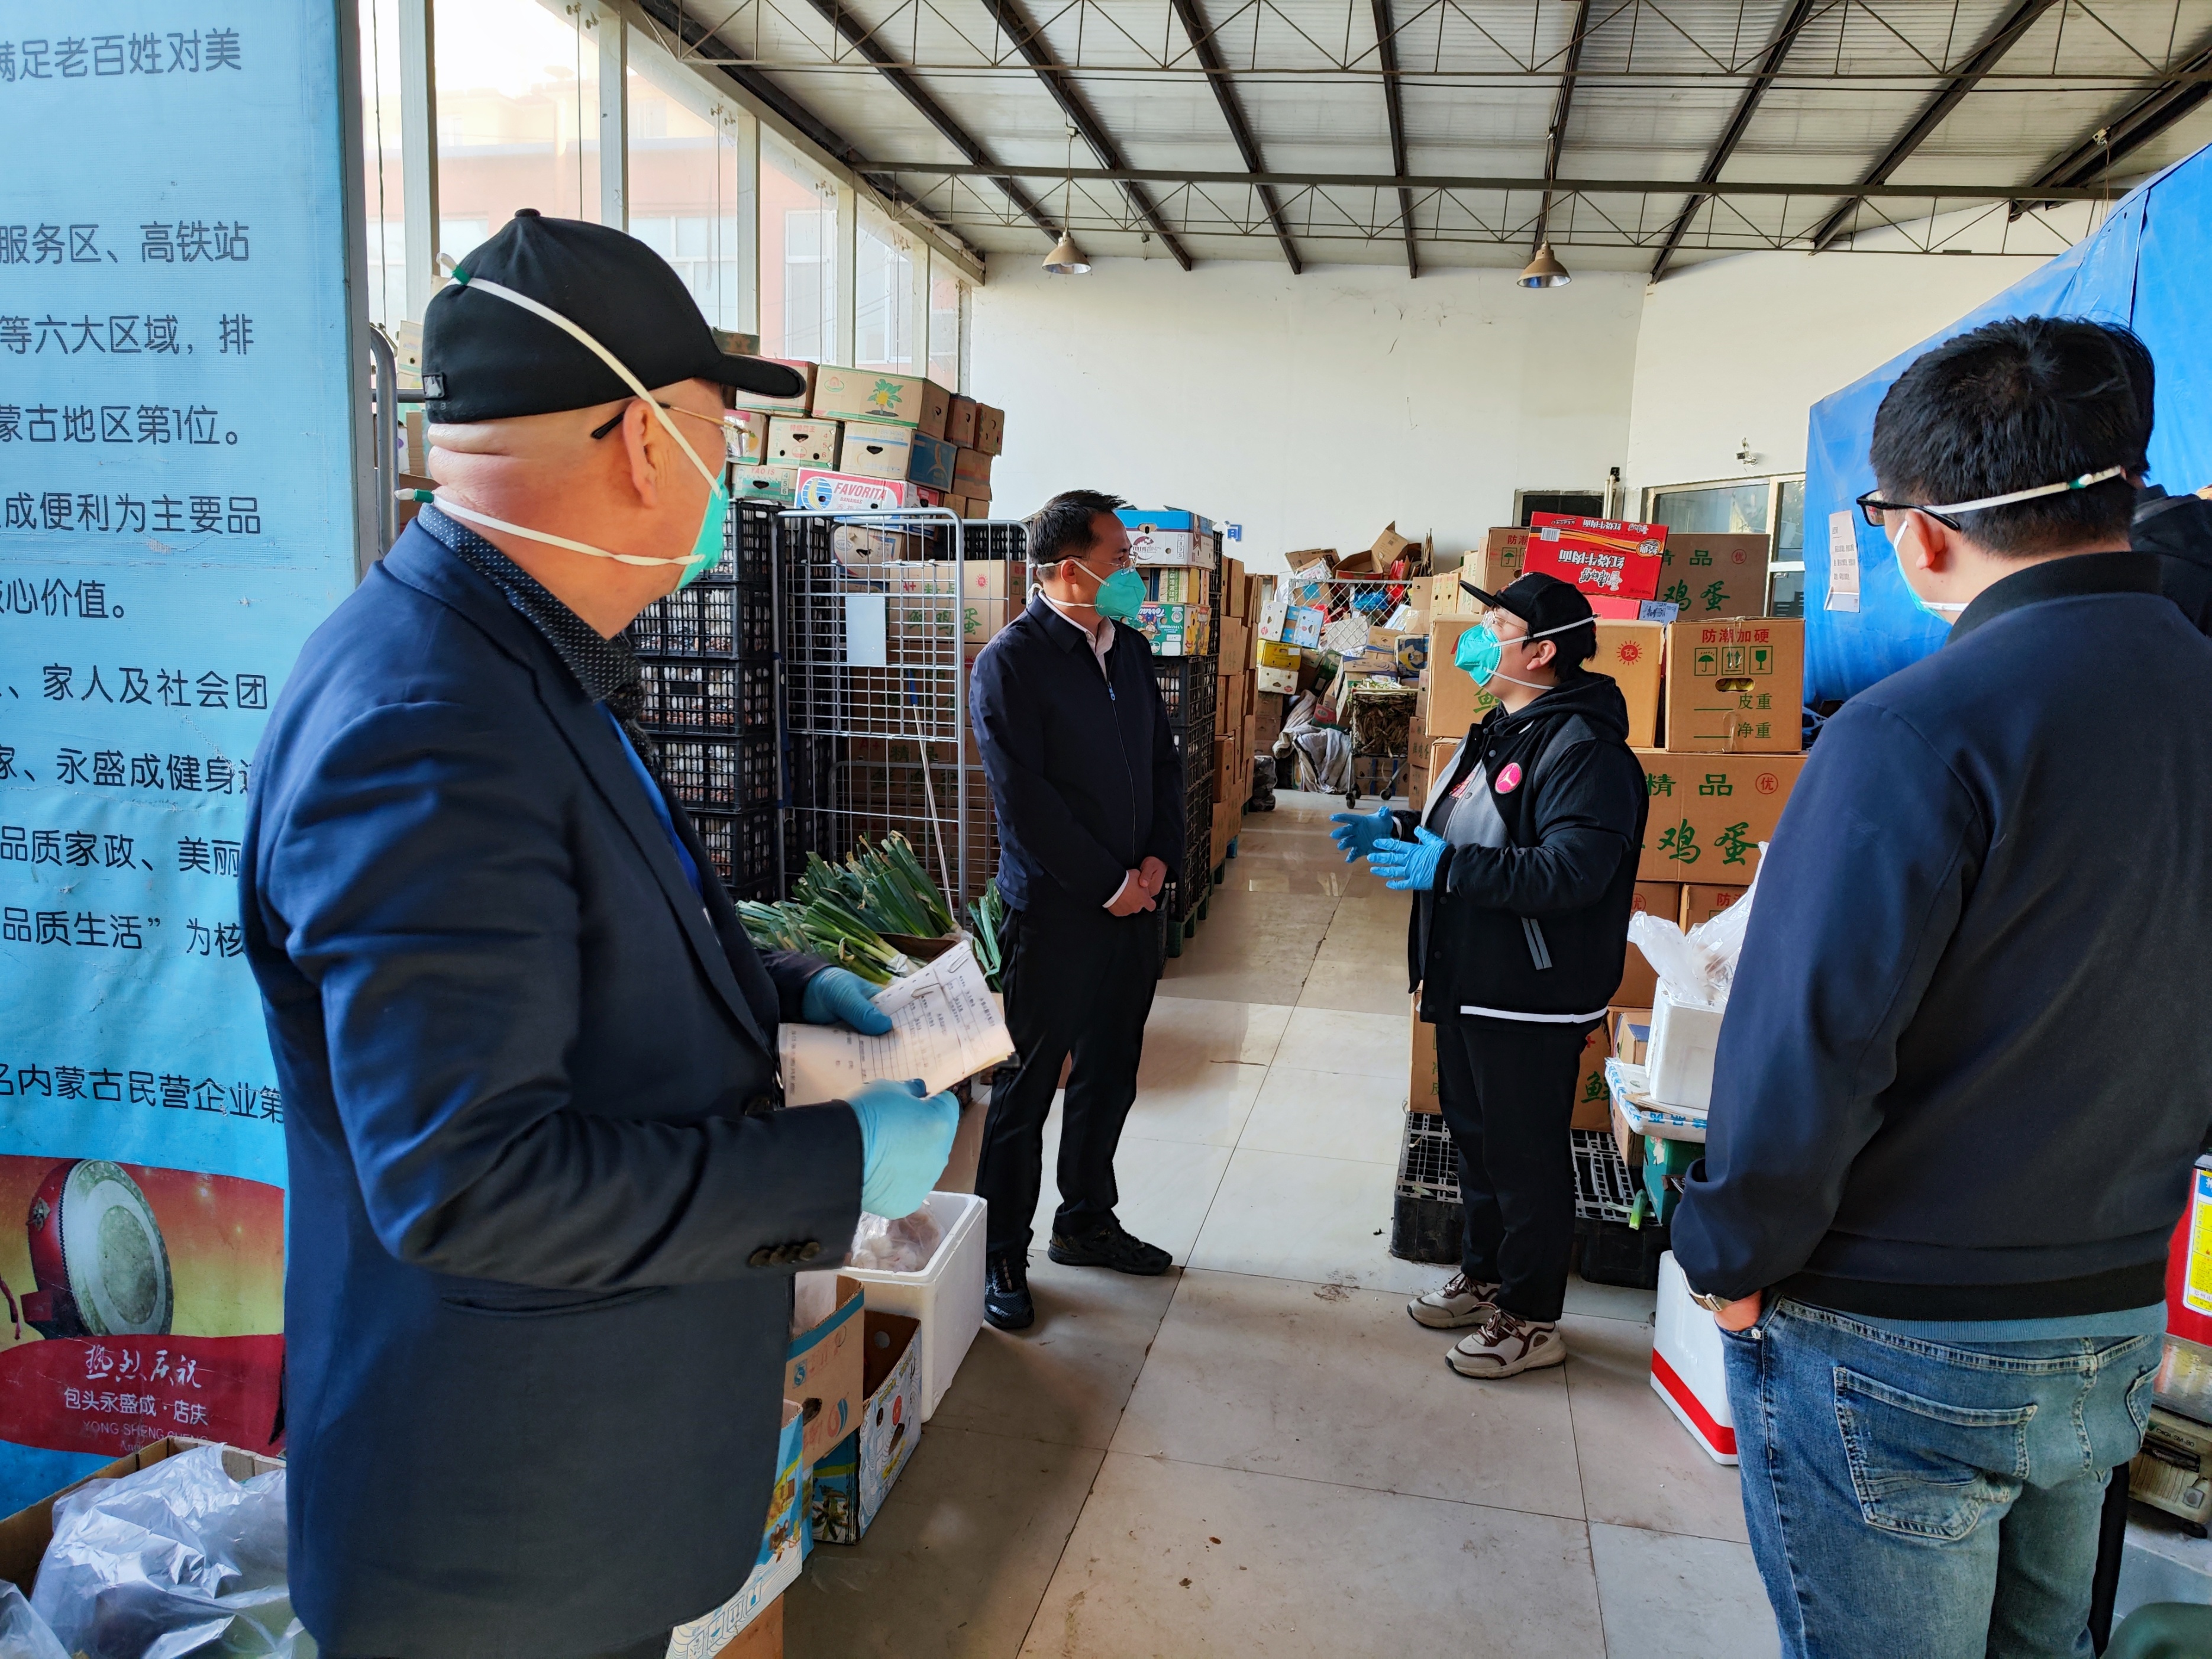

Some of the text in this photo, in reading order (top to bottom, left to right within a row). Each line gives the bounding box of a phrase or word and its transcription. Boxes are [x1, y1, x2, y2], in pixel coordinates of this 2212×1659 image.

[0, 221, 249, 264] 服务区、高铁站
[0, 404, 238, 446] 蒙古地区第1位。
[834, 482, 887, 501] FAVORITA
[5, 492, 260, 534] 成便利为主要品
[1583, 519, 1622, 531] 红烧牛肉面
[1558, 549, 1626, 569] 红烧牛肉面
[1639, 543, 1658, 555] 经典
[0, 577, 124, 619] 心价值。
[1663, 579, 1730, 611] 鸡蛋
[1702, 628, 1770, 643] 防潮加硬
[1738, 693, 1772, 709] 皮重
[1737, 722, 1772, 738] 净重
[1645, 773, 1733, 797] 精品
[1656, 819, 1759, 866] 鸡蛋
[85, 1344, 202, 1389] 热烈庆祝
[83, 1421, 119, 1435] YONG
[122, 1423, 164, 1440] SHENG
[2156, 1428, 2171, 1438] DIGI
